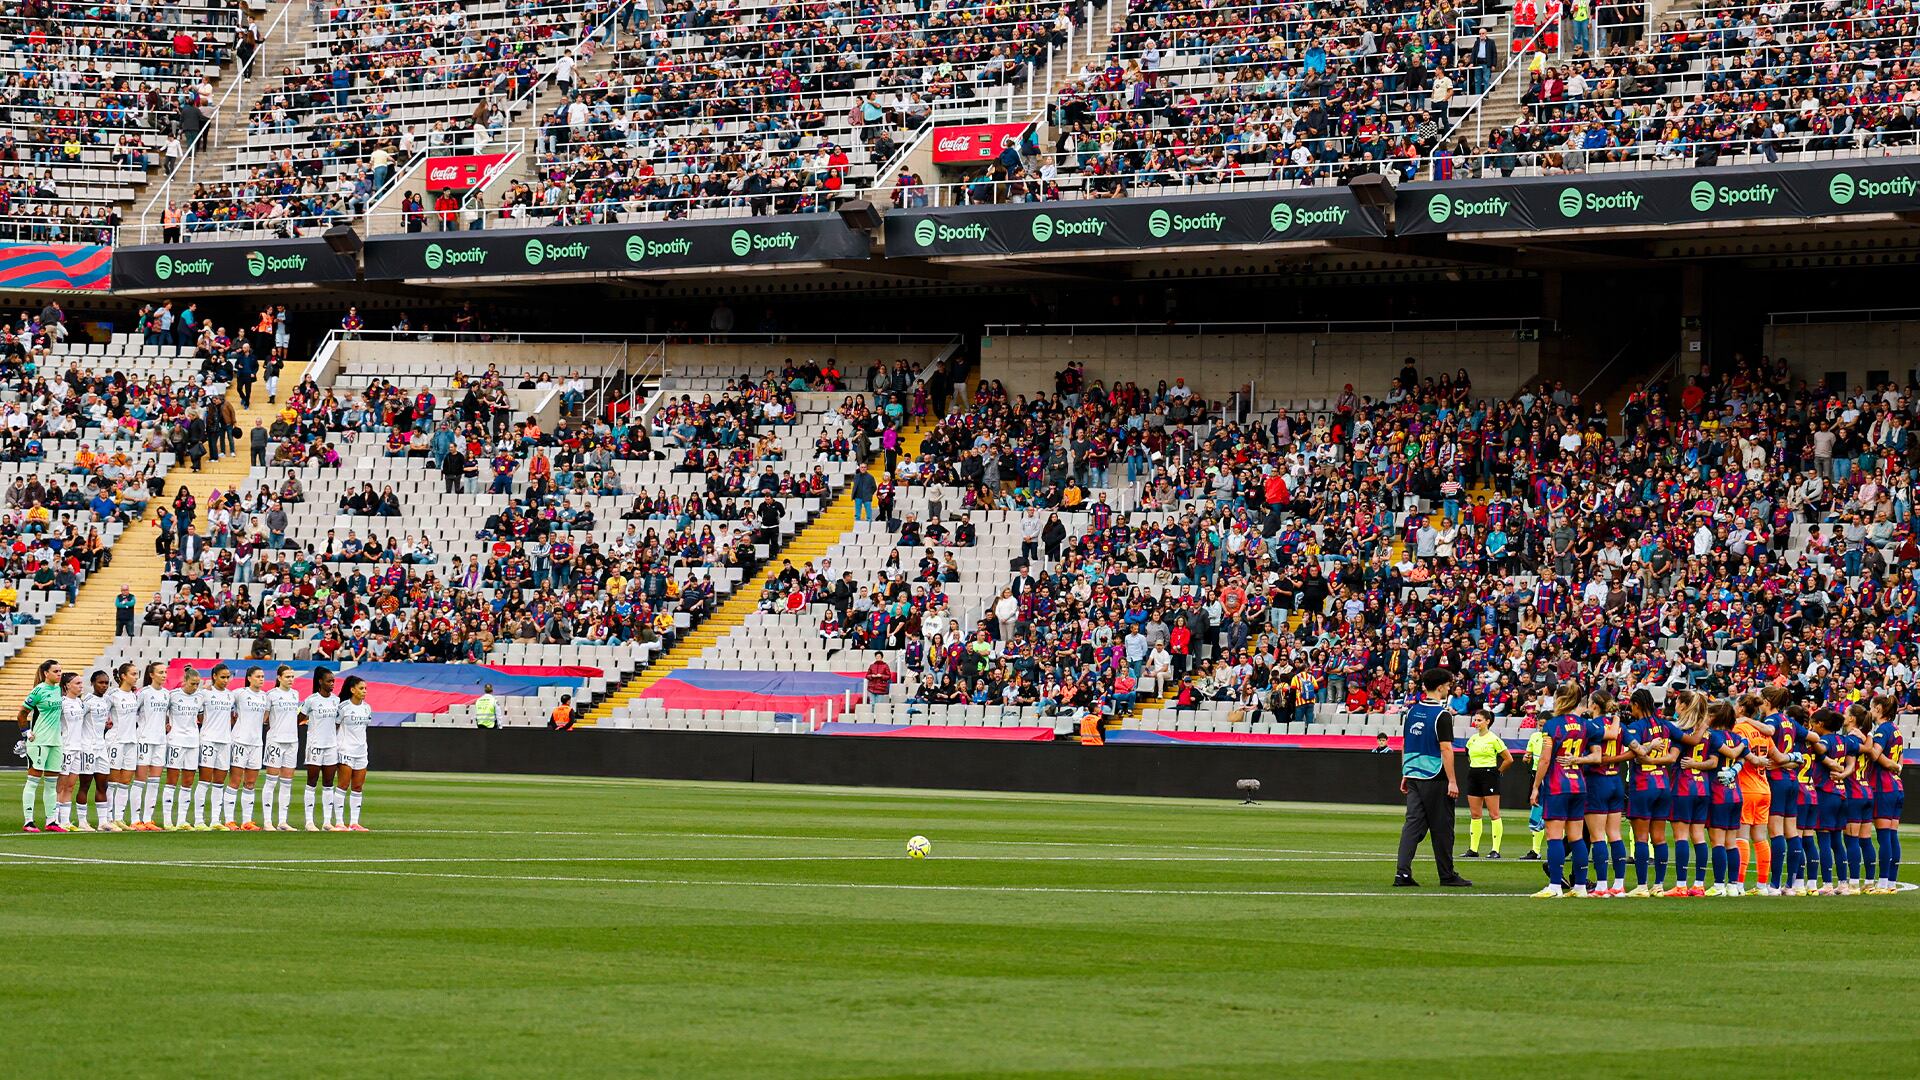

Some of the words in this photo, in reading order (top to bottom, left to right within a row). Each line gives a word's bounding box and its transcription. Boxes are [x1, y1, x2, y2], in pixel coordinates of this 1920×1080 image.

[1719, 183, 1776, 205] Spotify
[1859, 176, 1916, 198] Spotify
[1454, 197, 1509, 218] Spotify
[1586, 190, 1641, 212] Spotify
[1173, 212, 1223, 232] Spotify
[1295, 206, 1347, 227] Spotify
[939, 222, 987, 242] Spotify
[1056, 217, 1105, 237] Spotify
[647, 237, 691, 257] Spotify
[753, 231, 797, 251] Spotify
[445, 247, 487, 265] Spotify
[546, 242, 588, 260] Spotify
[174, 258, 212, 275] Spotify
[267, 254, 305, 272] Spotify
[37, 745, 42, 757] 1
[138, 743, 149, 754] 10
[170, 747, 179, 758] 16
[202, 745, 214, 757] 23
[270, 746, 281, 757] 24
[84, 753, 95, 764] 18
